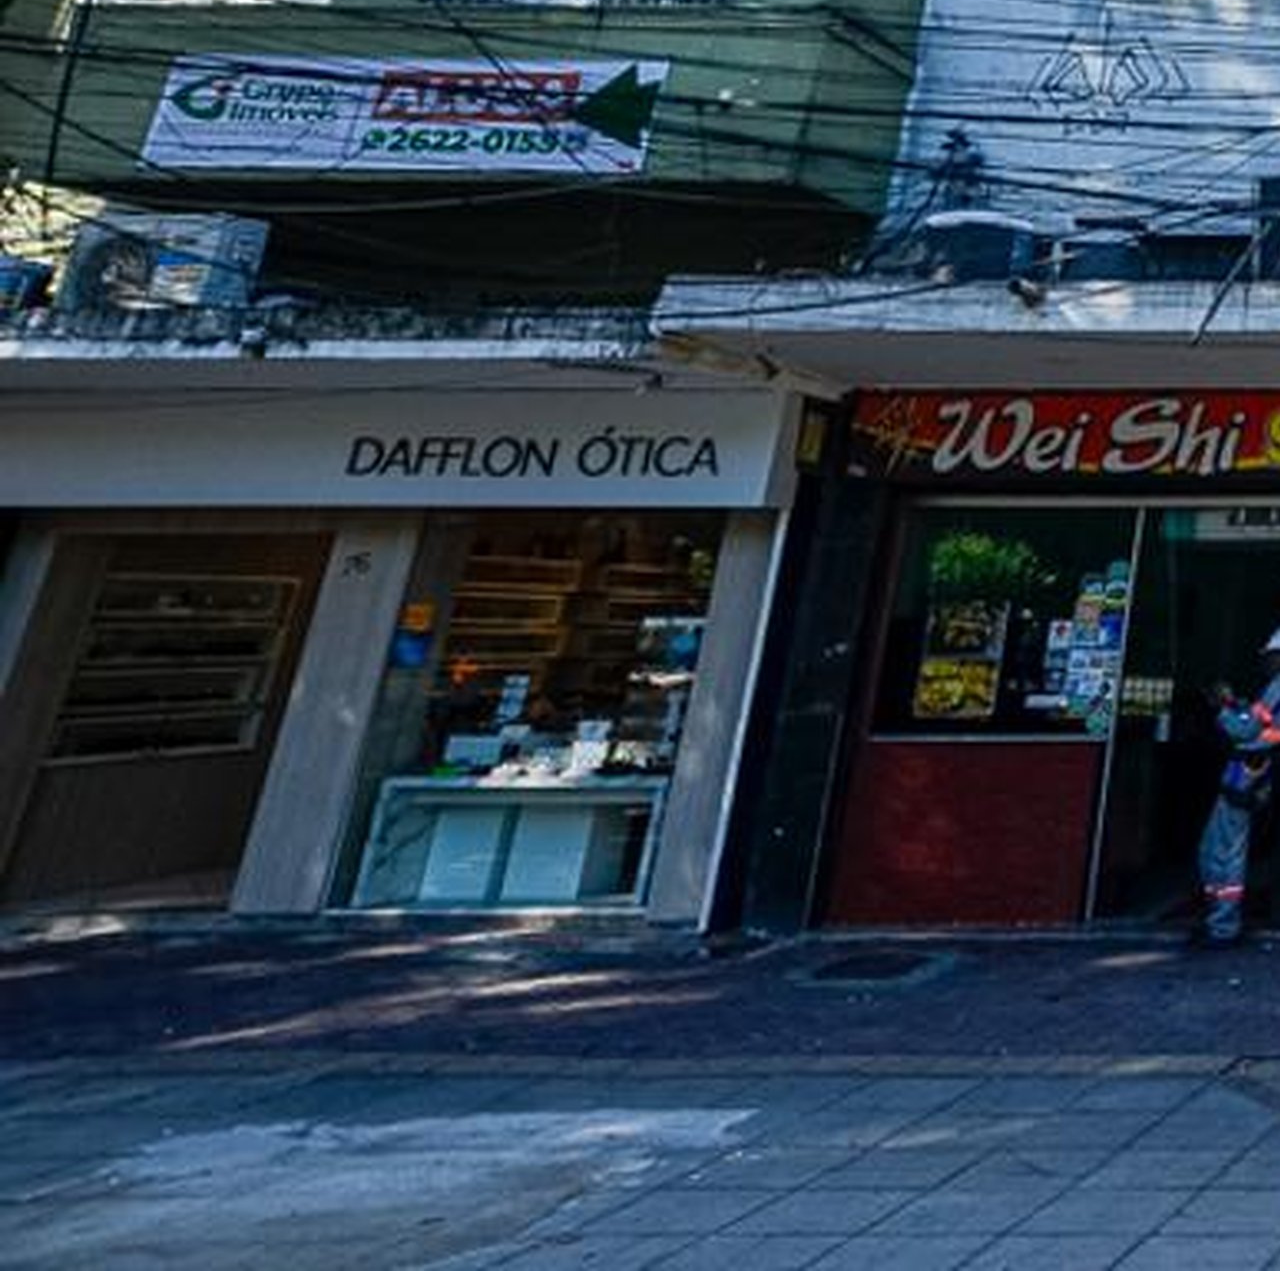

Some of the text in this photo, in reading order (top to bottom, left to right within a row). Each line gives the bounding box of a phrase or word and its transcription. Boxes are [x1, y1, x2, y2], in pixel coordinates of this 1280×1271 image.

[345, 426, 718, 477] DAFFLON ÓTICA
[932, 397, 1092, 473] Wei
[1102, 399, 1246, 476] Shi
